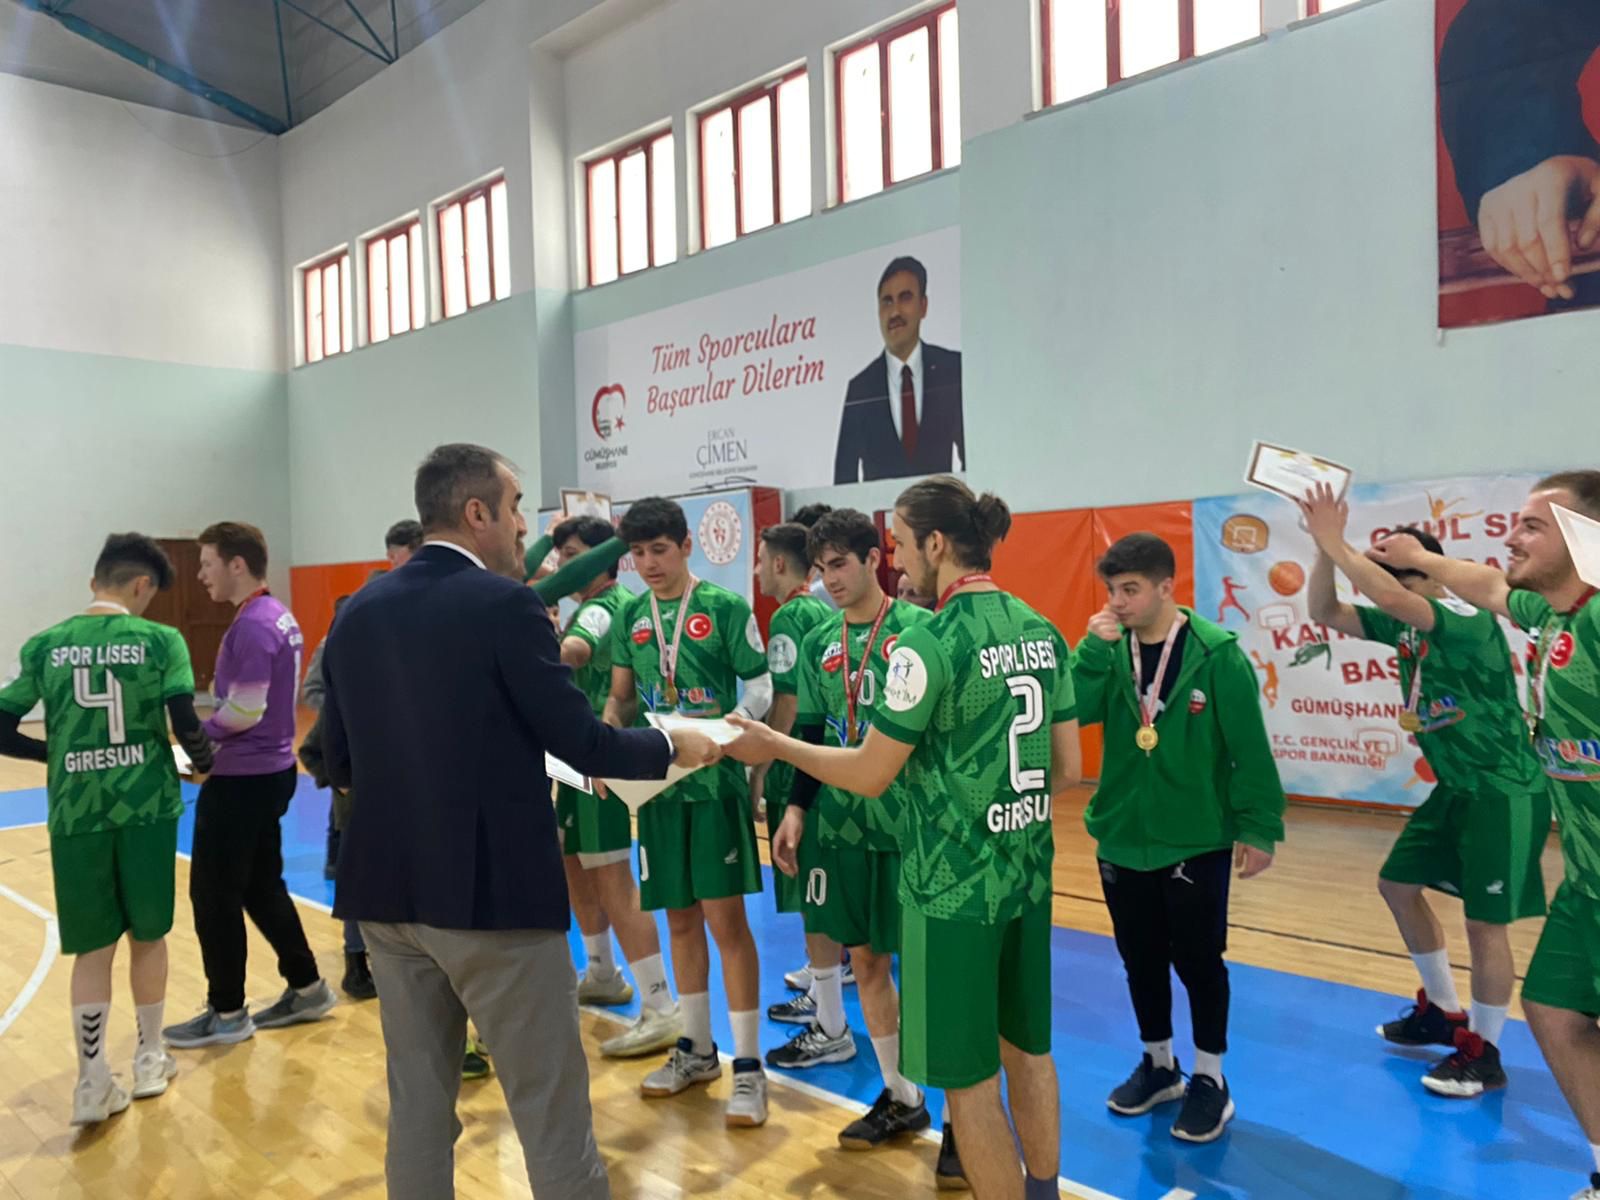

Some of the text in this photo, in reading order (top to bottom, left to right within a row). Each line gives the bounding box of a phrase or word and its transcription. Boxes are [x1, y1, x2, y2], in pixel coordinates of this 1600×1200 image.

[652, 313, 817, 374] Tüm Sporculara
[647, 355, 824, 417] Başarılar Dilerim
[696, 438, 748, 471] ÇİMEN
[51, 641, 146, 668] SPOR LİSESİ
[73, 667, 126, 745] 4
[1005, 673, 1046, 794] 2
[1272, 734, 1381, 752] T.C. GENÇLİK VE
[1273, 748, 1384, 769] SPOR BAKANLIĞI
